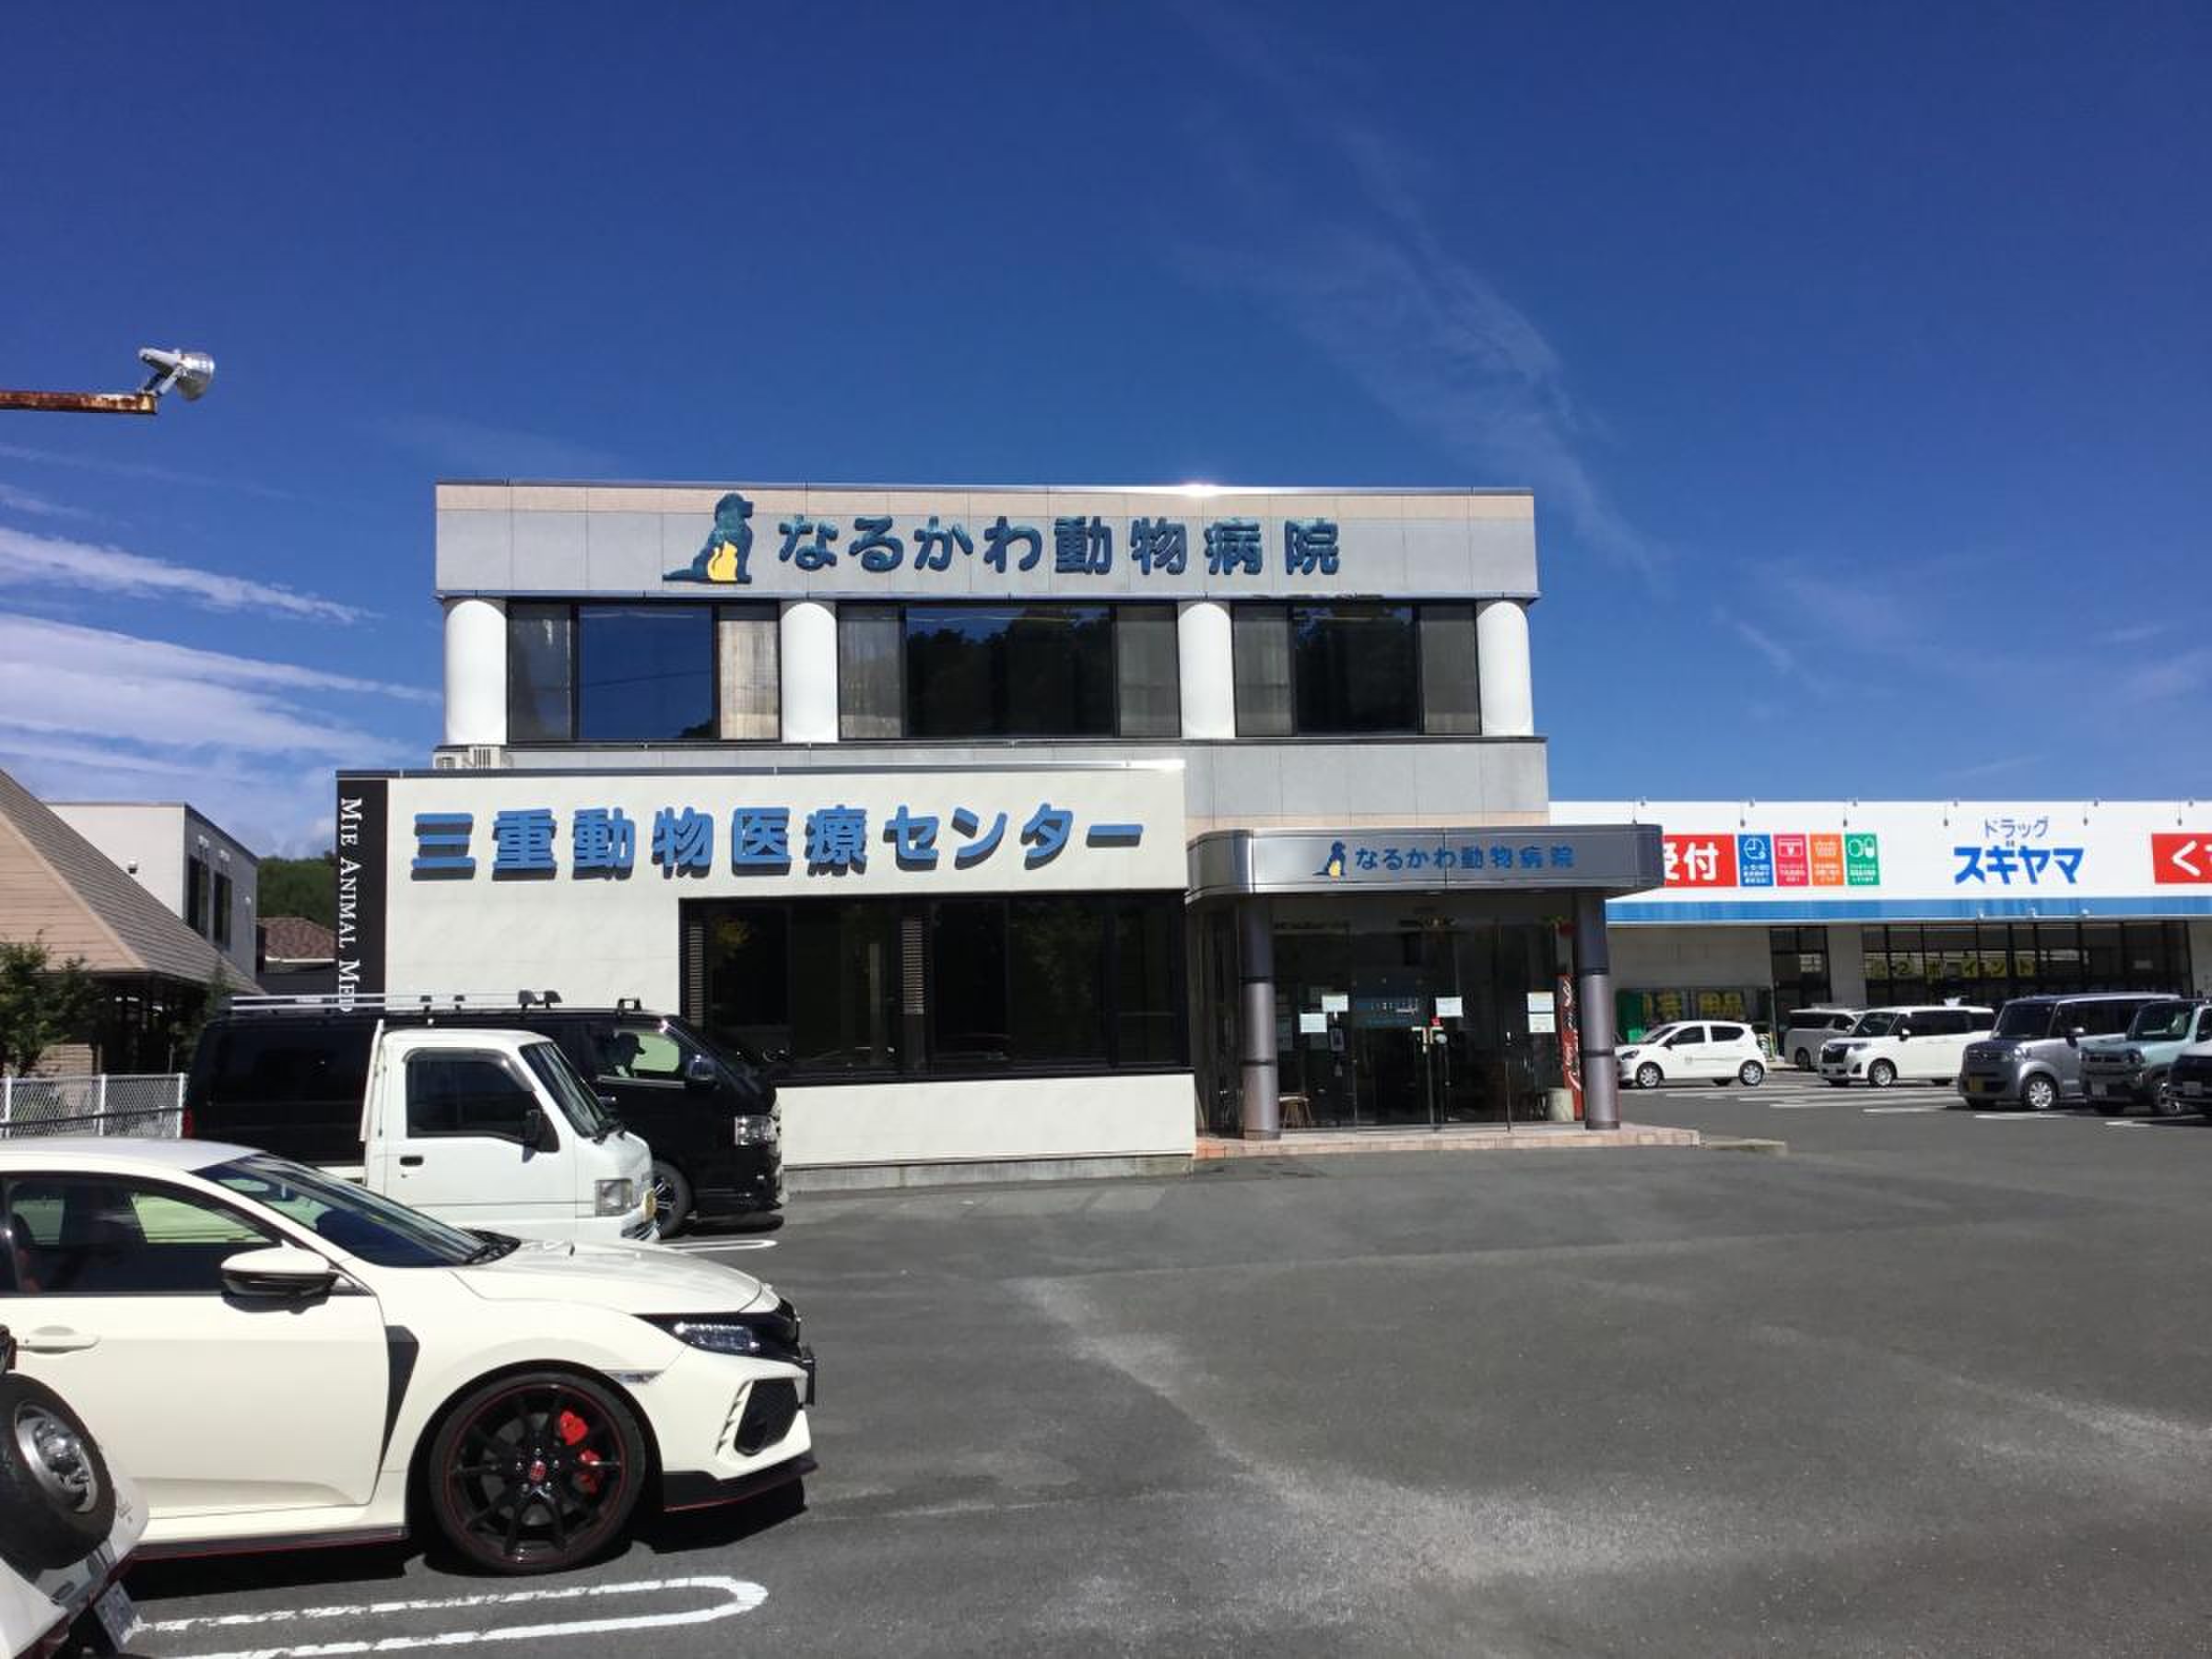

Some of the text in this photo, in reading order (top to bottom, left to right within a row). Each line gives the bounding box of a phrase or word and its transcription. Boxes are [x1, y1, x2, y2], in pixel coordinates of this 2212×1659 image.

[778, 515, 1339, 576] なるかわ動物病院
[411, 804, 1144, 881] 三重動物医療センター
[1984, 816, 2049, 838] ドラッグ
[1355, 845, 1574, 869] なるかわ動物病院
[1953, 841, 2084, 885] スギヤマ
